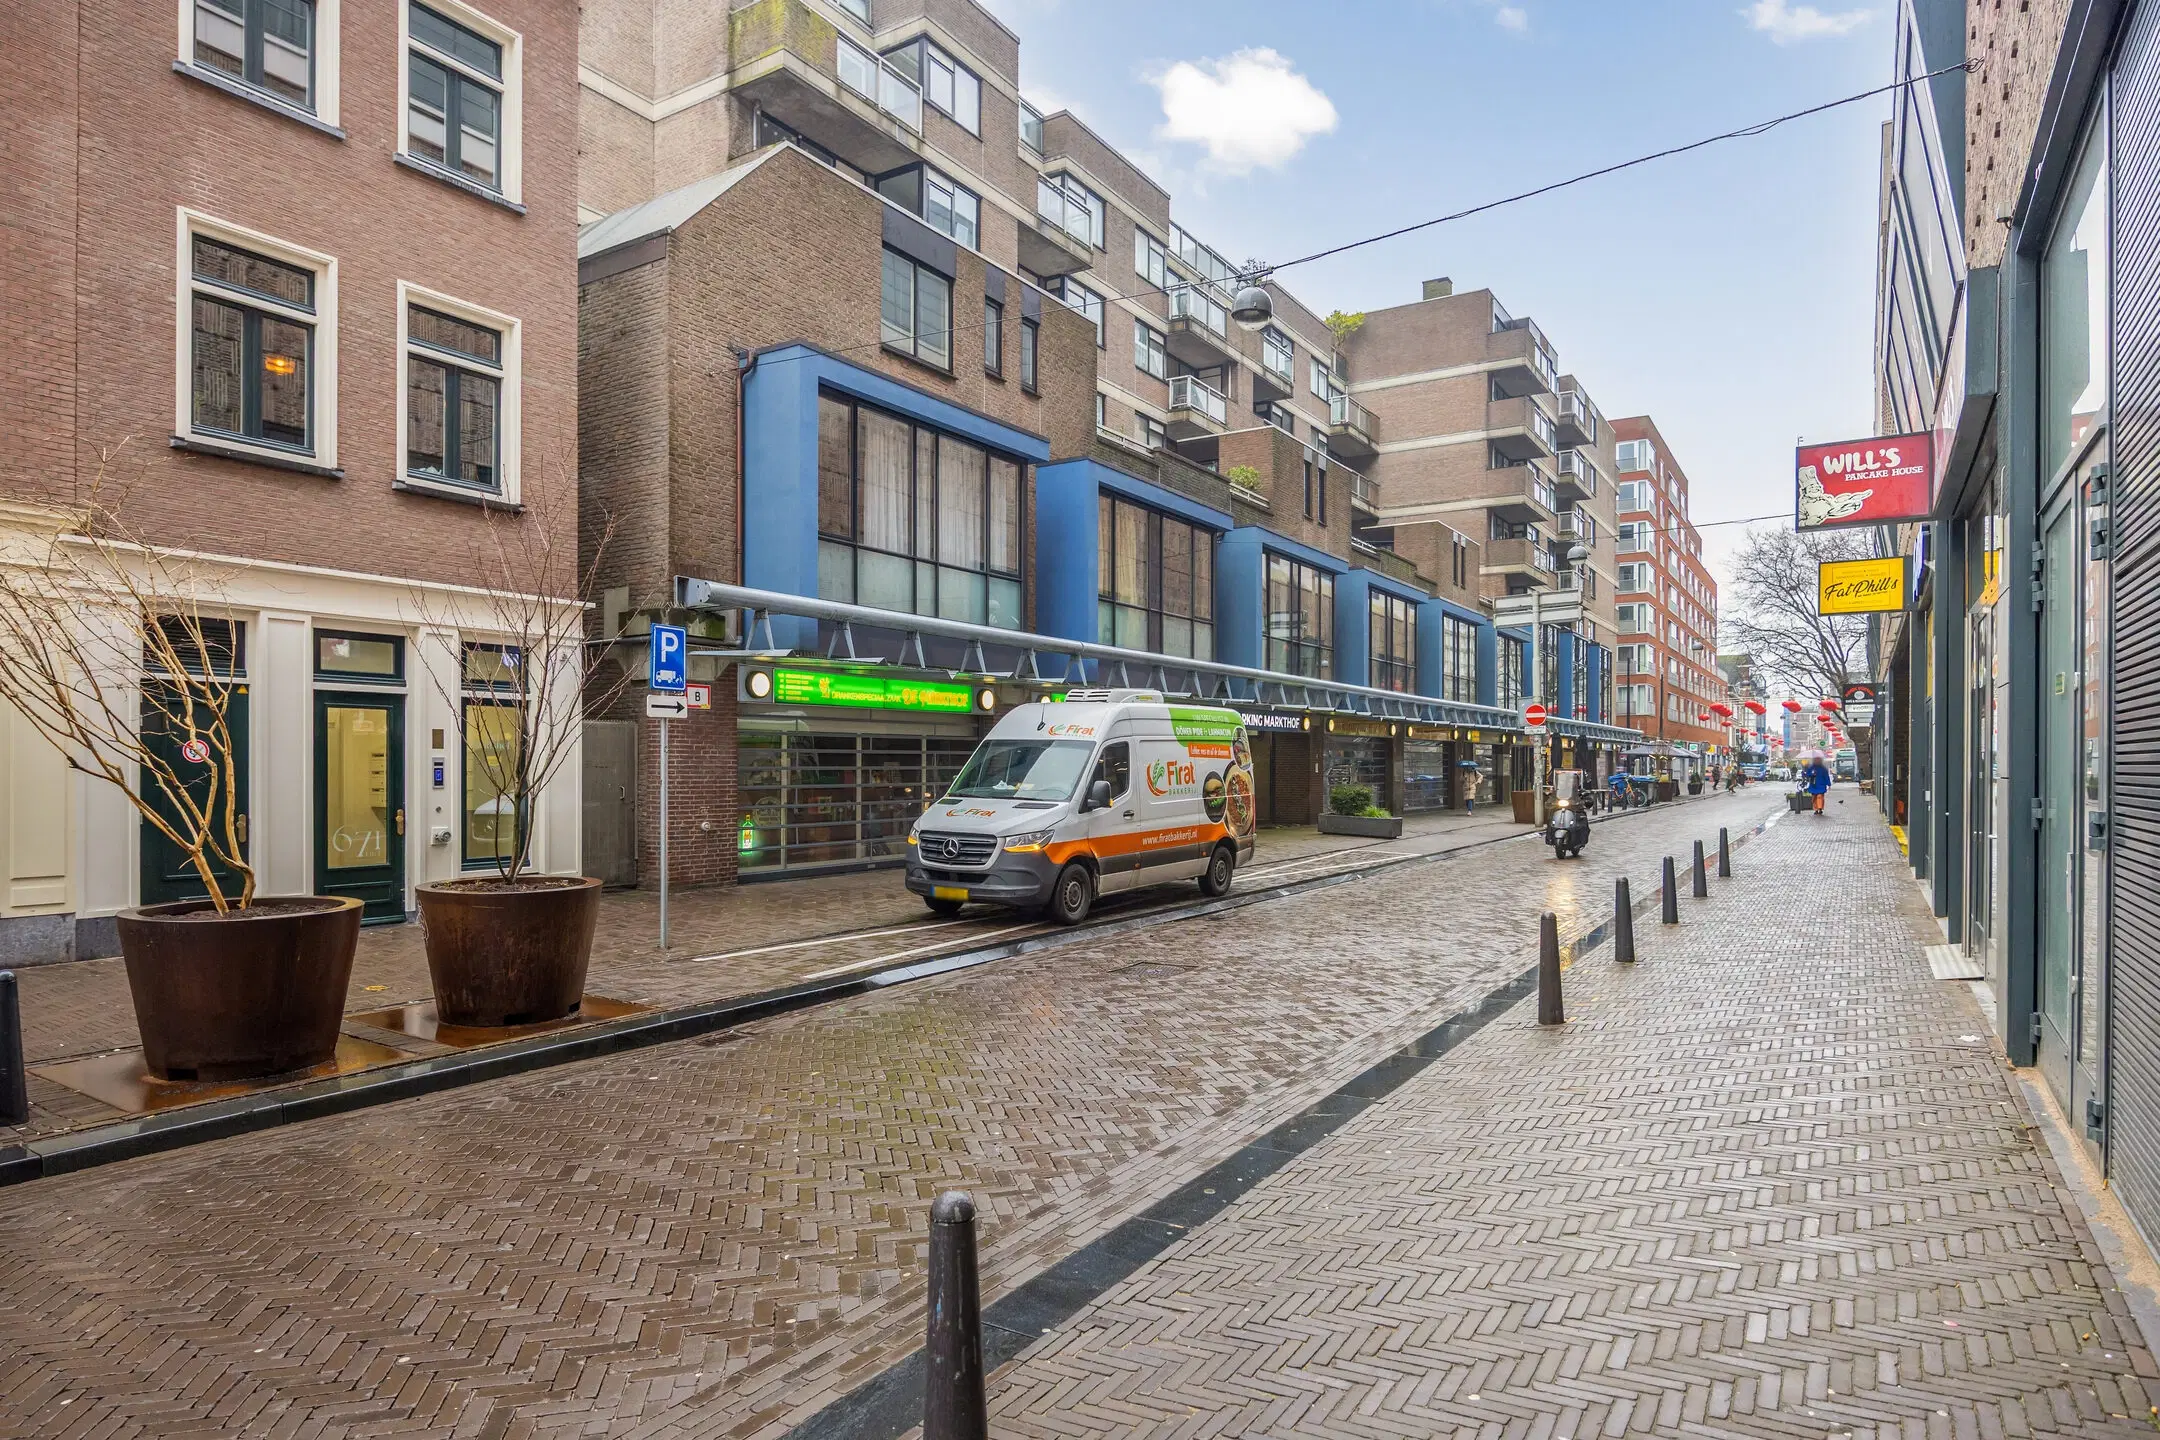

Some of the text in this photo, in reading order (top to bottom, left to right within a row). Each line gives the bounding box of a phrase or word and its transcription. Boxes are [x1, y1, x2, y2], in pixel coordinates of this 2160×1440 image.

[1823, 447, 1901, 475] WILL'S
[1845, 465, 1924, 482] PANCAKE HOUSE
[1824, 576, 1899, 601] Fat Phill's
[661, 631, 679, 663] P
[694, 691, 701, 702] B
[1242, 713, 1300, 728] RKING MARKTHOF
[1066, 724, 1095, 736] Firat
[1166, 760, 1195, 786] Firat
[1142, 829, 1198, 846] www.firatbakkerij.nl
